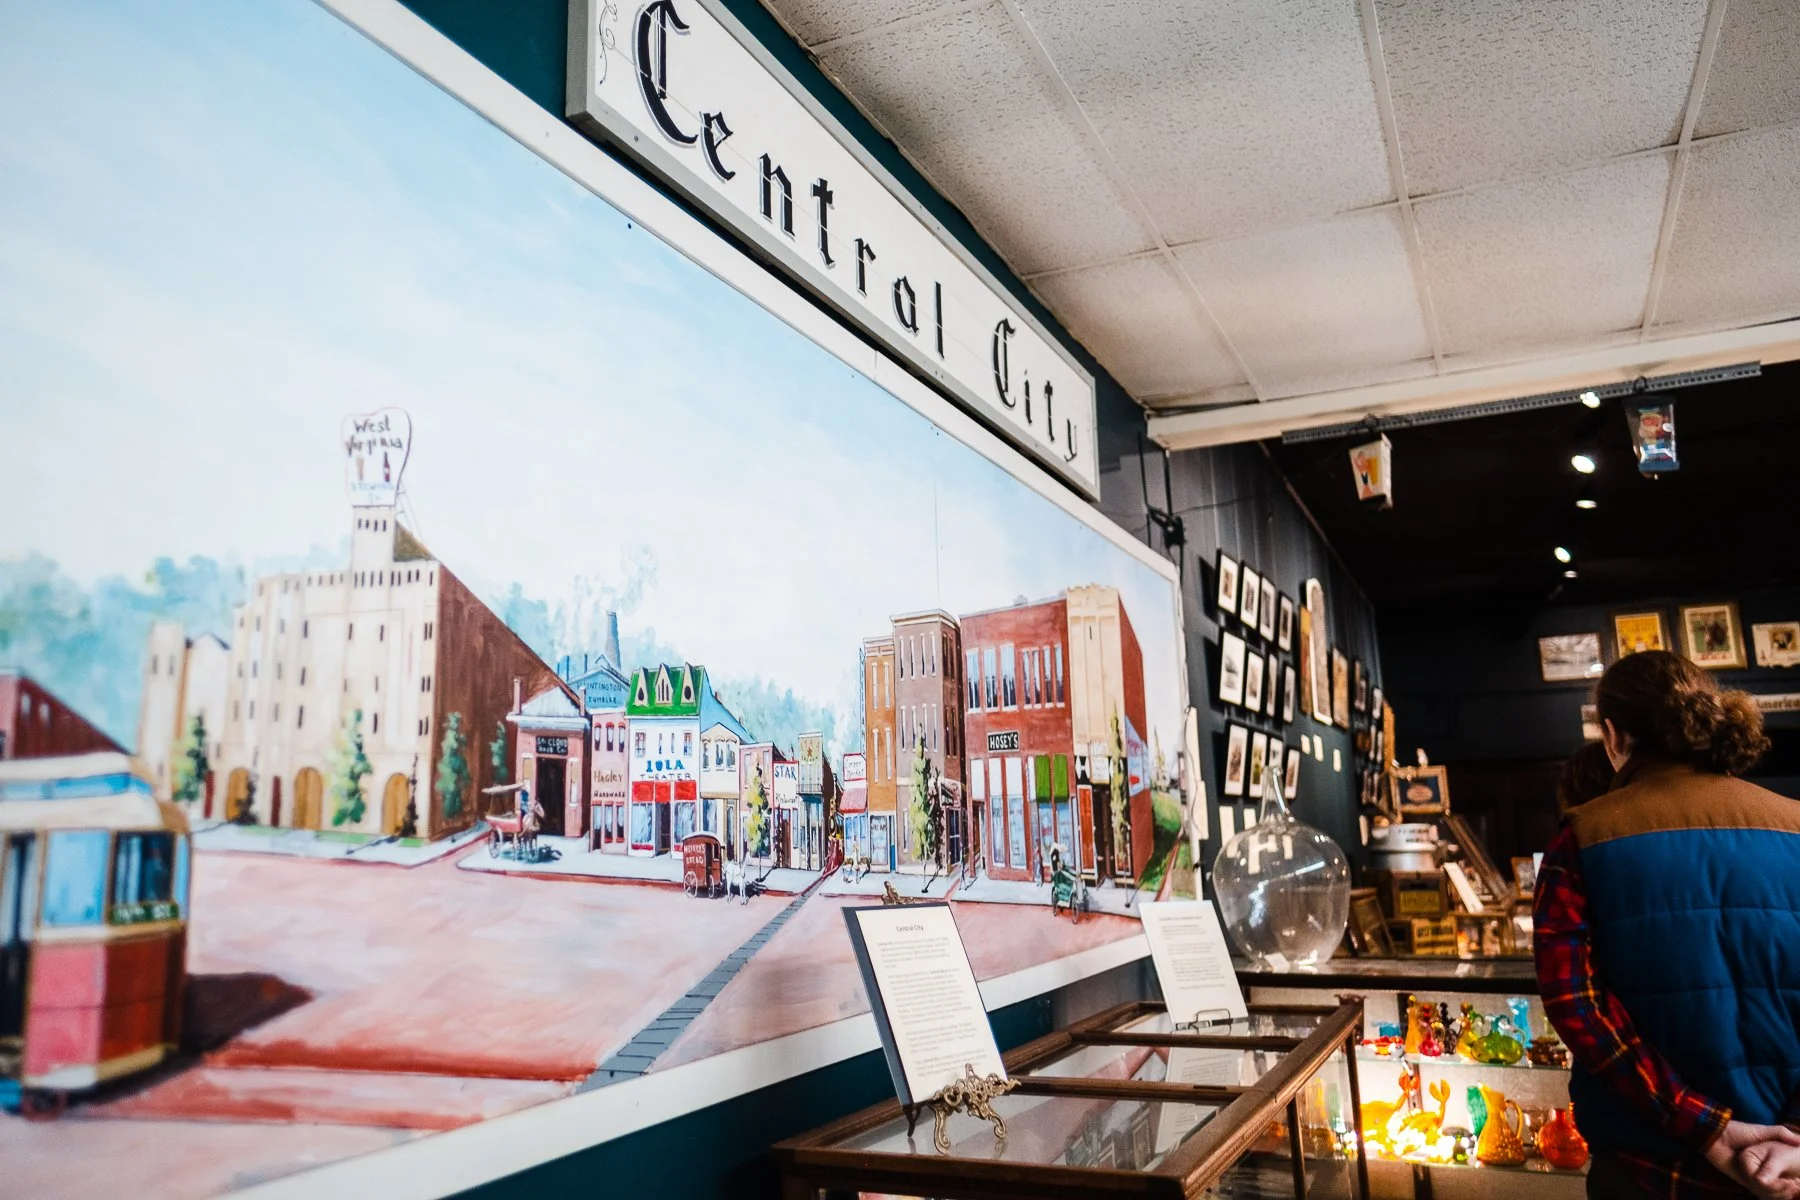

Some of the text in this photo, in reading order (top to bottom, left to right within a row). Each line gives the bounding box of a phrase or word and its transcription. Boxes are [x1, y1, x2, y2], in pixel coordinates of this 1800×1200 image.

[631, 0, 1078, 462] Central City
[990, 734, 1018, 749] HOSEY'S
[646, 759, 686, 772] IOLA
[775, 765, 797, 780] STAR
[640, 772, 692, 782] THEATER
